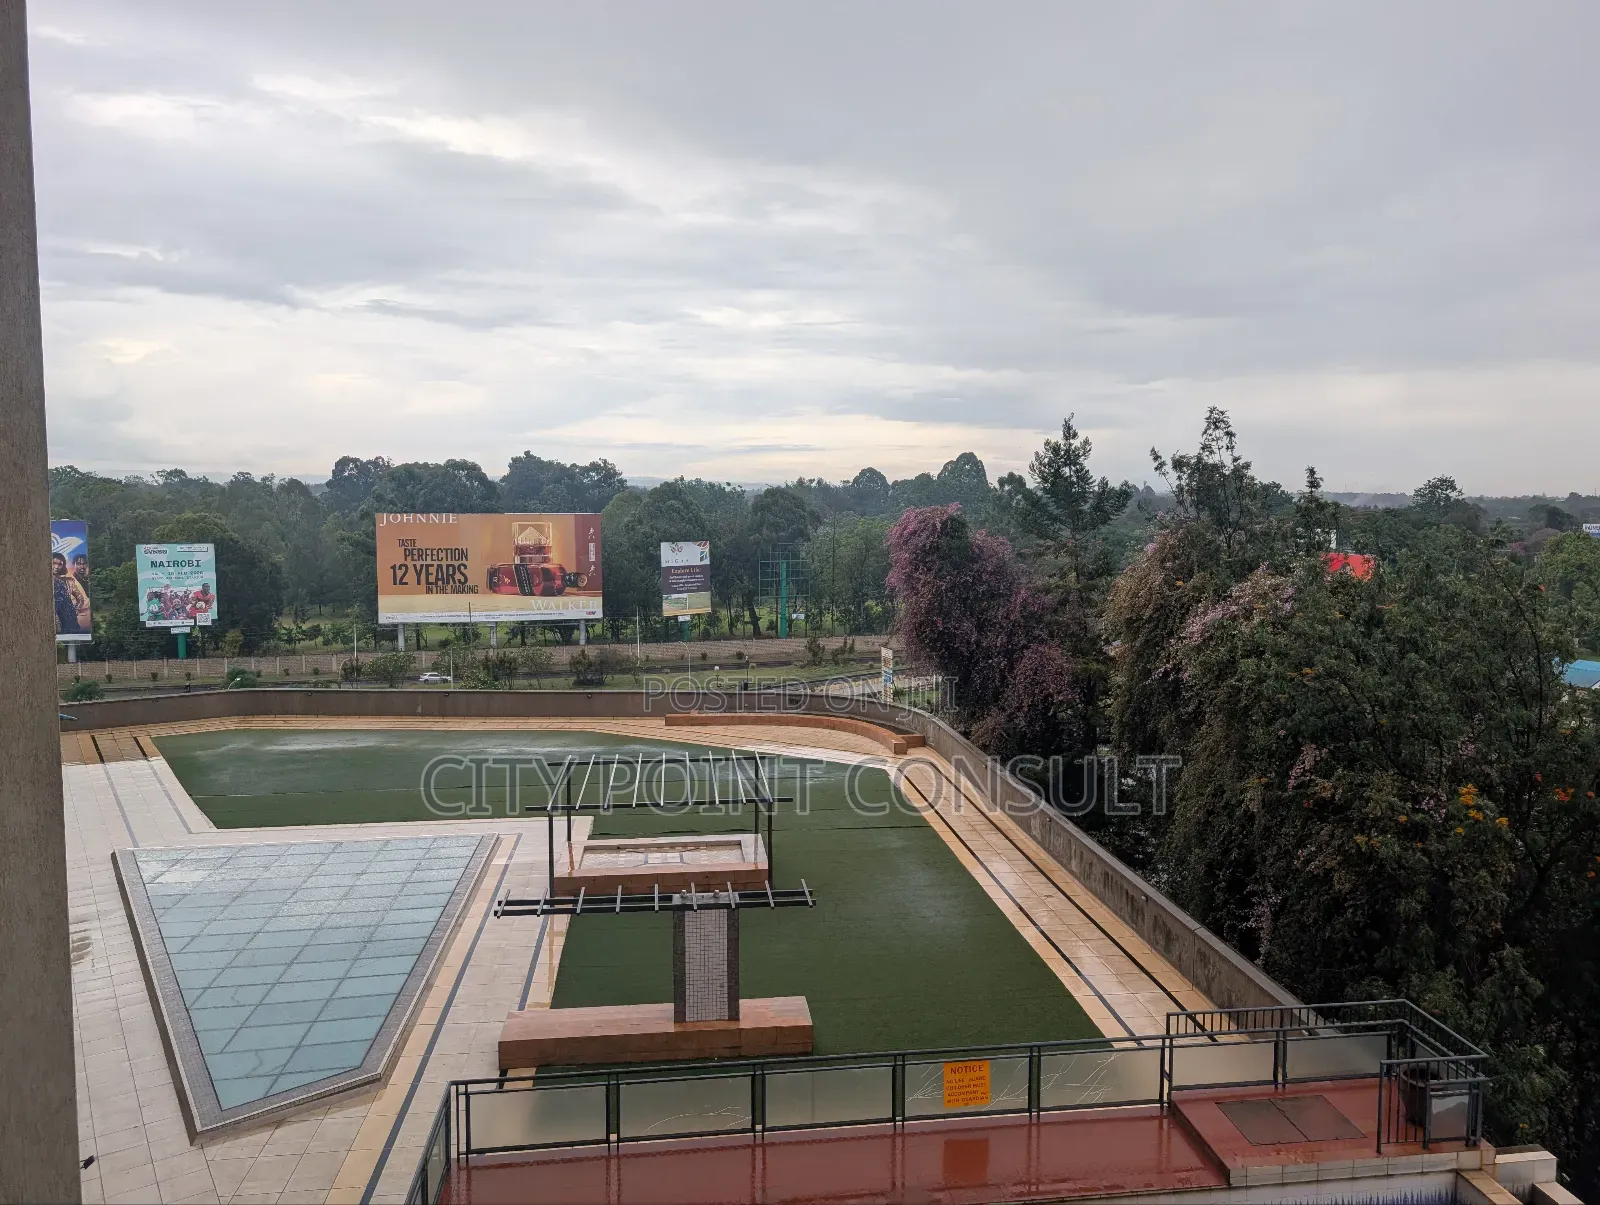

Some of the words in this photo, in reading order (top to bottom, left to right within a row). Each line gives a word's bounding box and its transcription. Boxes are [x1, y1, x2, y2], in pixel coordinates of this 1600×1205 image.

[380, 513, 457, 526] JOHNNIE
[397, 538, 417, 547] TASTE
[404, 548, 468, 562] PERFECTION
[150, 559, 201, 568] NAIROBI
[390, 563, 409, 585] 12
[412, 563, 468, 585] YEARS
[425, 585, 434, 594] IN
[435, 585, 449, 594] THE
[450, 585, 478, 594] MAKING
[531, 600, 597, 610] WALKER
[951, 1065, 983, 1074] NOTICE
